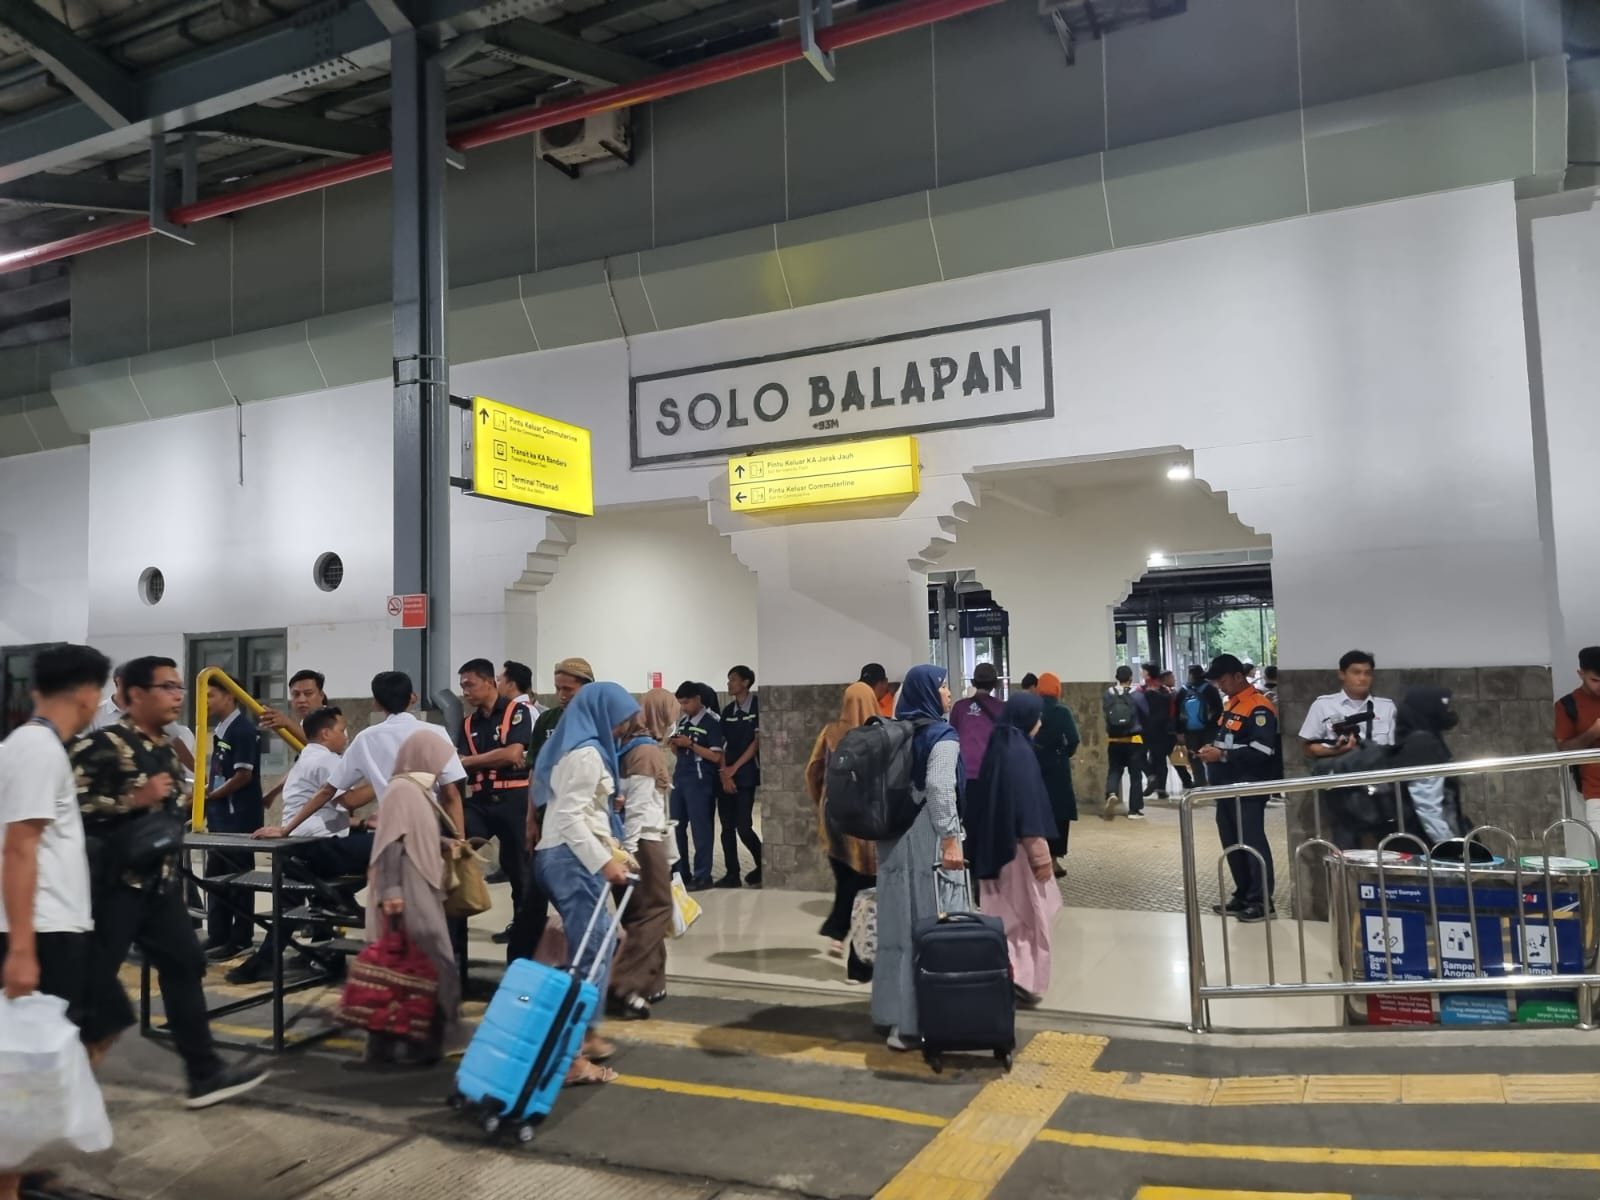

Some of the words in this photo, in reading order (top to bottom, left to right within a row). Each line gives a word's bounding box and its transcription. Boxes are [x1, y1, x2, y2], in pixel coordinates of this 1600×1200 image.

[655, 381, 790, 437] SOLO
[808, 345, 1023, 417] BALAPAN
[524, 421, 542, 432] Keluar
[543, 426, 578, 442] Commuterline
[510, 446, 529, 458] Transit
[546, 455, 567, 468] Bandara
[785, 458, 806, 466] Keluar
[806, 456, 817, 464] KA
[818, 454, 836, 463] Jarak
[837, 452, 854, 461] Jauh
[511, 474, 535, 486] Terminal
[536, 479, 559, 492] Tirtonadi
[786, 484, 807, 492] Keluar
[808, 479, 855, 490] Commuterline
[1369, 954, 1403, 965] Samah
